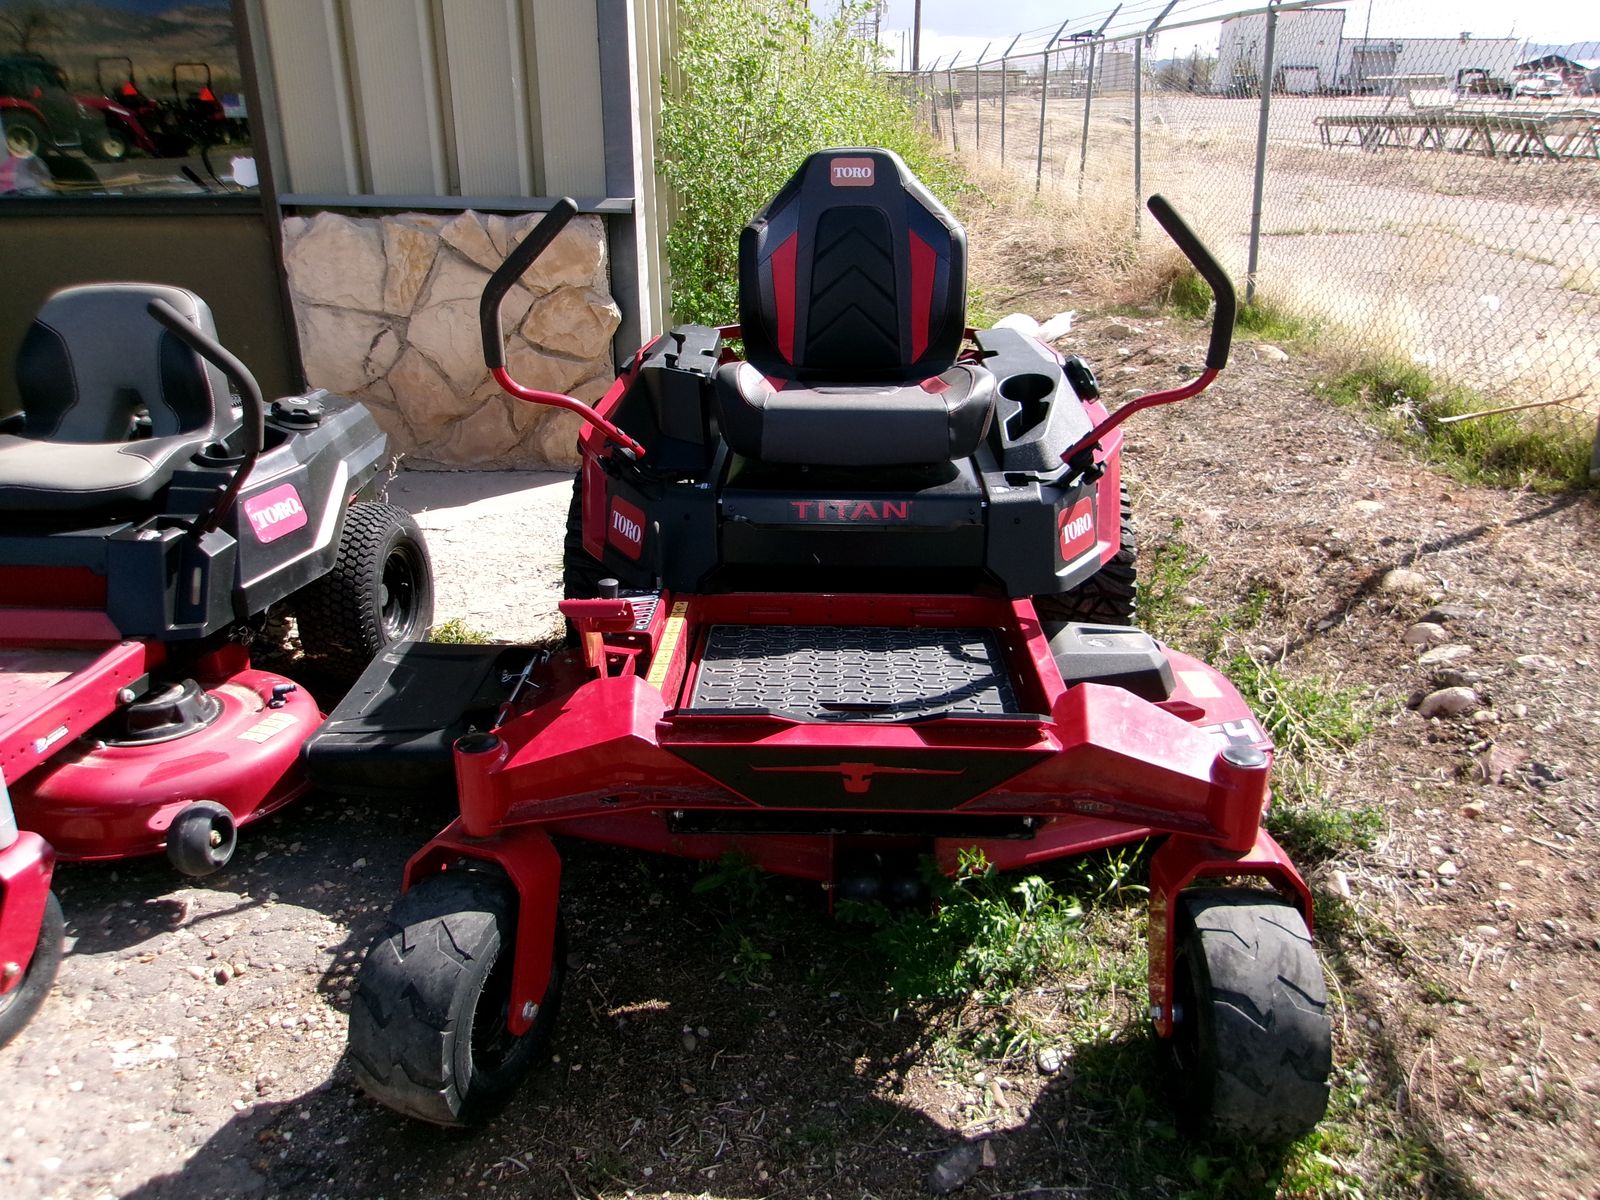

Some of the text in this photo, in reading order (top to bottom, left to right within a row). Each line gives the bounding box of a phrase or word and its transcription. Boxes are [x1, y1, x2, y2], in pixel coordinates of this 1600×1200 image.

[833, 167, 872, 178] TORO
[251, 497, 303, 529] TORO
[790, 500, 908, 519] TITAN
[613, 510, 641, 543] TORO
[1062, 512, 1092, 544] TORO
